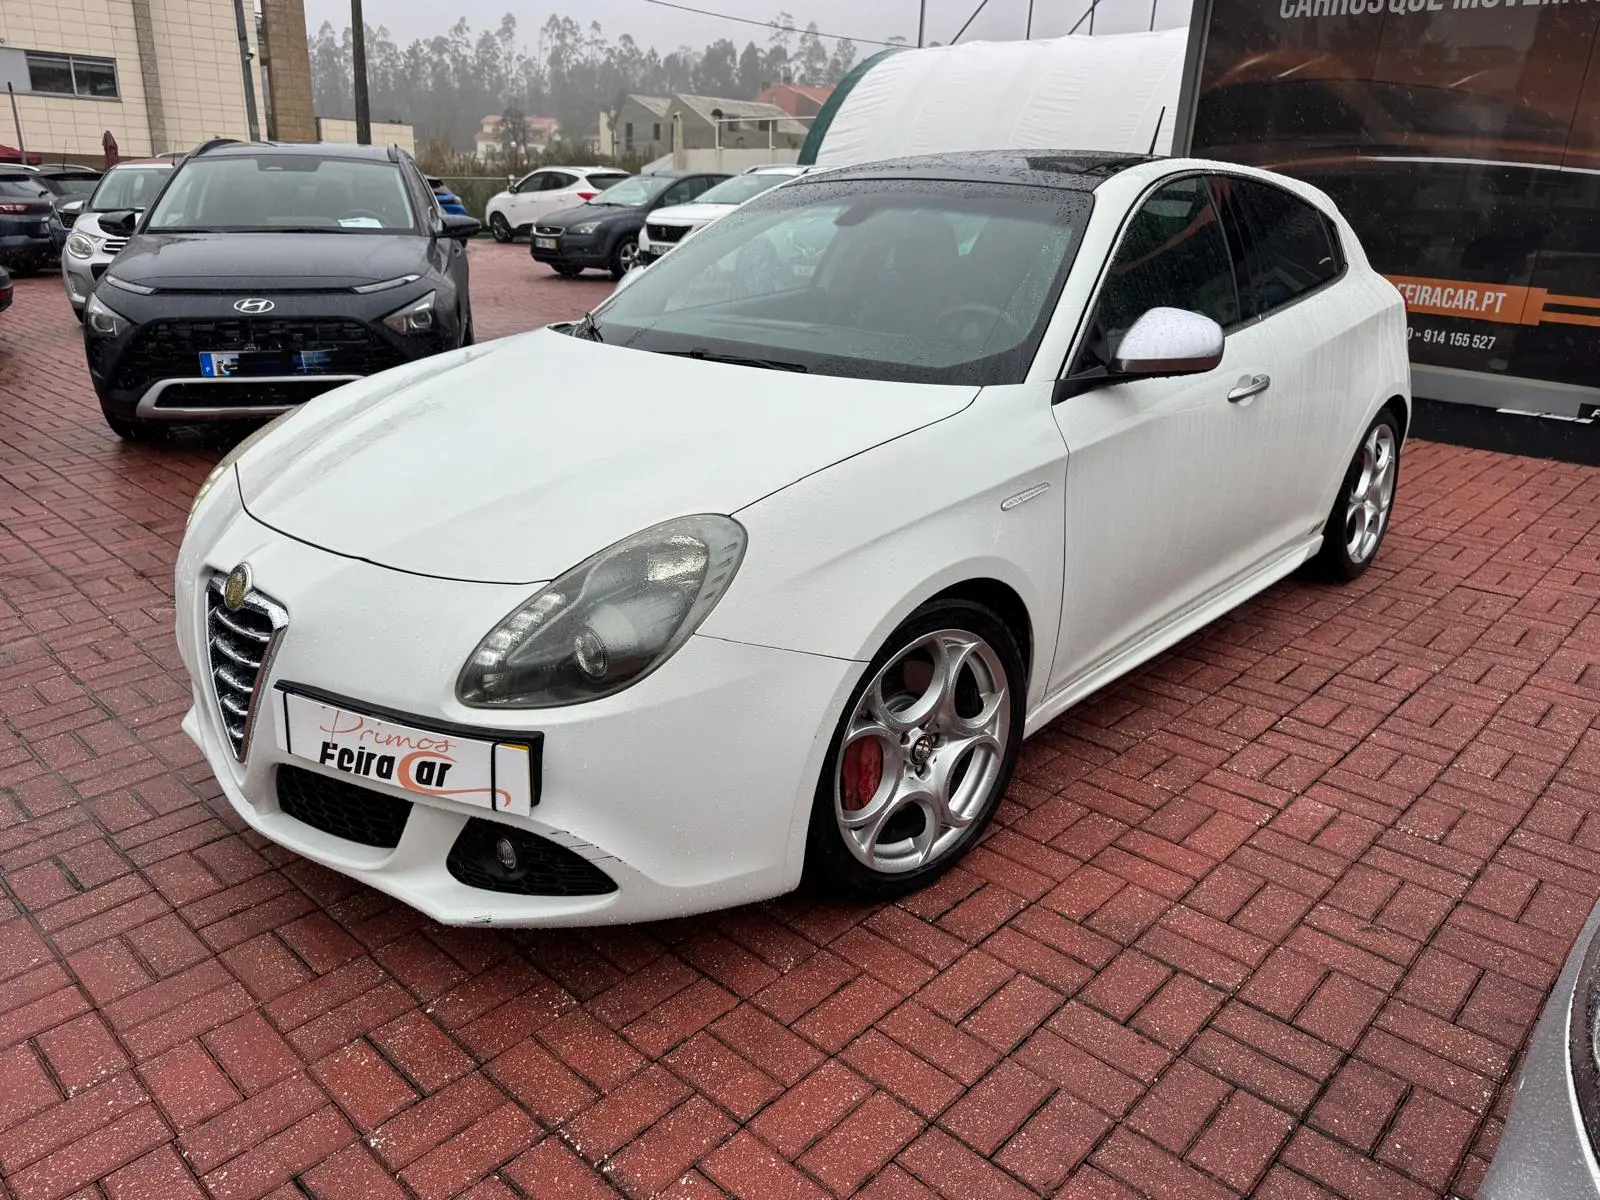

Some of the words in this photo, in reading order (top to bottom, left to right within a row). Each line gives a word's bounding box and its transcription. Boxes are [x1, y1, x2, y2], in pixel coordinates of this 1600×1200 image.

[1423, 329, 1445, 344] 914
[1449, 331, 1470, 347] 155
[1472, 334, 1496, 350] 527
